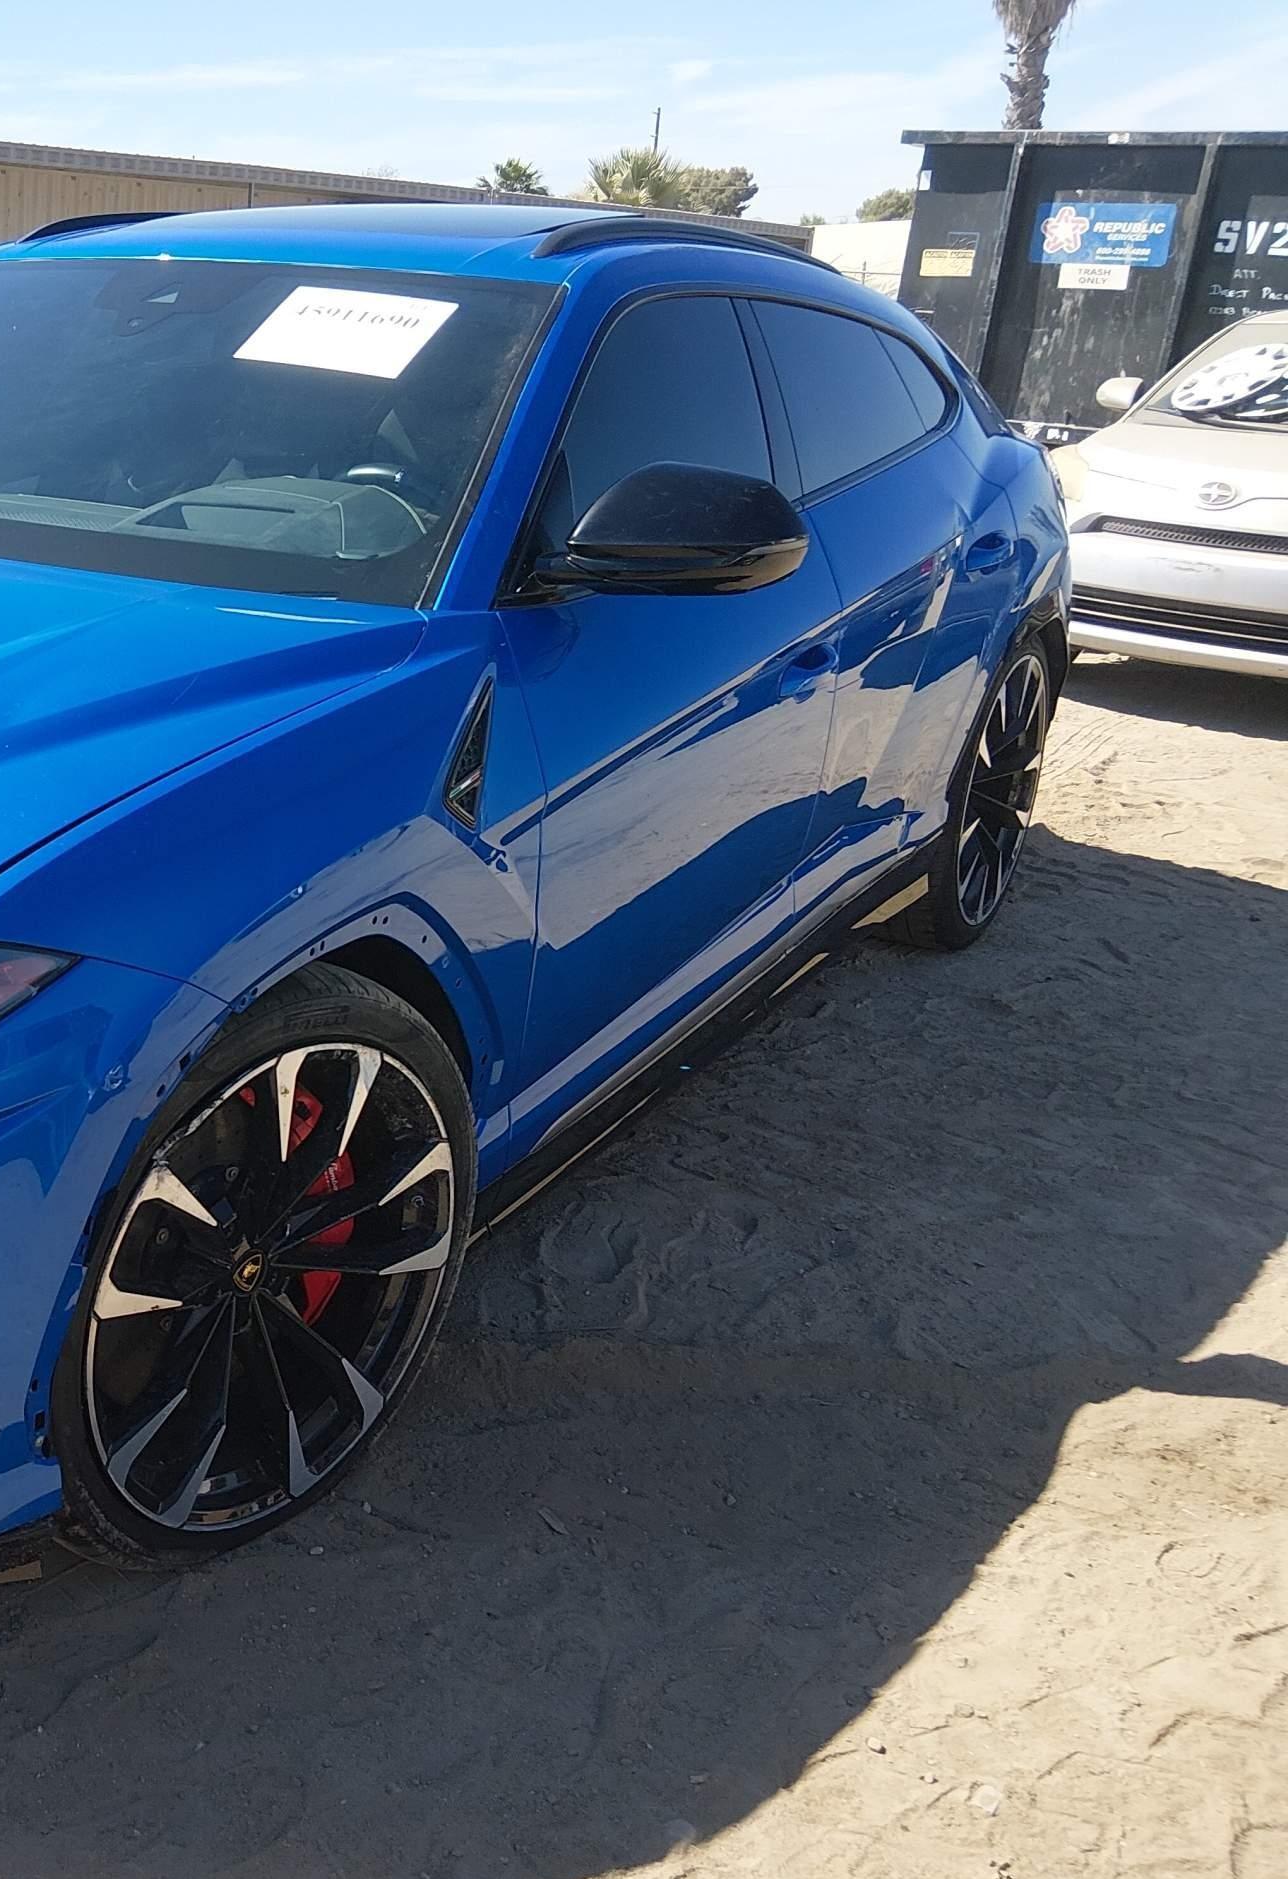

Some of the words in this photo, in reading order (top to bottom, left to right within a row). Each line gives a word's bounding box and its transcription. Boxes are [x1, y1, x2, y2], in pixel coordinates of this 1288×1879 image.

[1093, 221, 1166, 234] REPUBLIC
[1078, 268, 1112, 276] TRASH
[1078, 277, 1109, 285] ONLY
